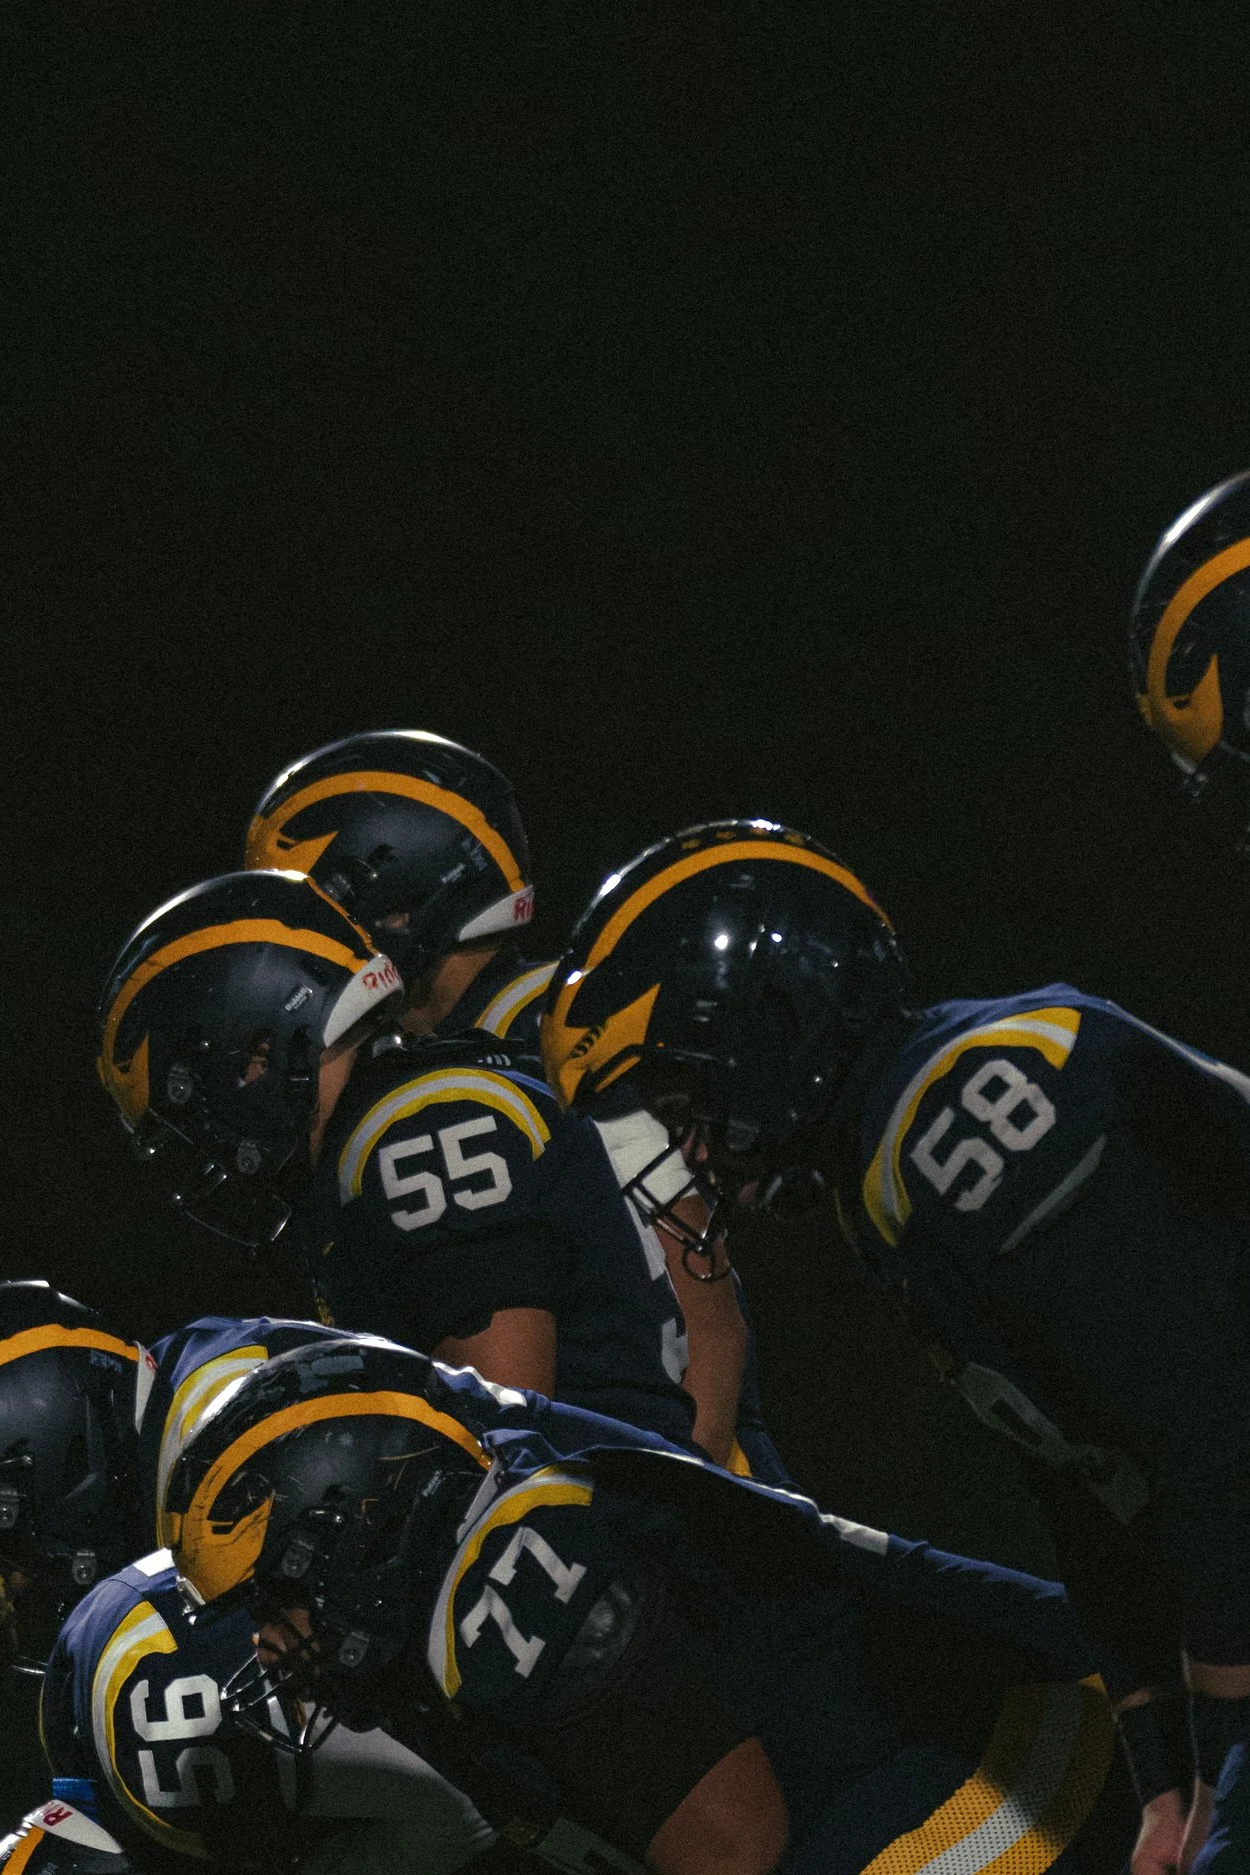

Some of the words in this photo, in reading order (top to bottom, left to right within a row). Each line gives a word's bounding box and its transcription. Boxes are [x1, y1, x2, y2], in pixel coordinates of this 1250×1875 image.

[379, 1115, 513, 1232] 55
[909, 1059, 1057, 1212] 58
[460, 1526, 588, 1678] 77
[130, 1673, 234, 1807] 56
